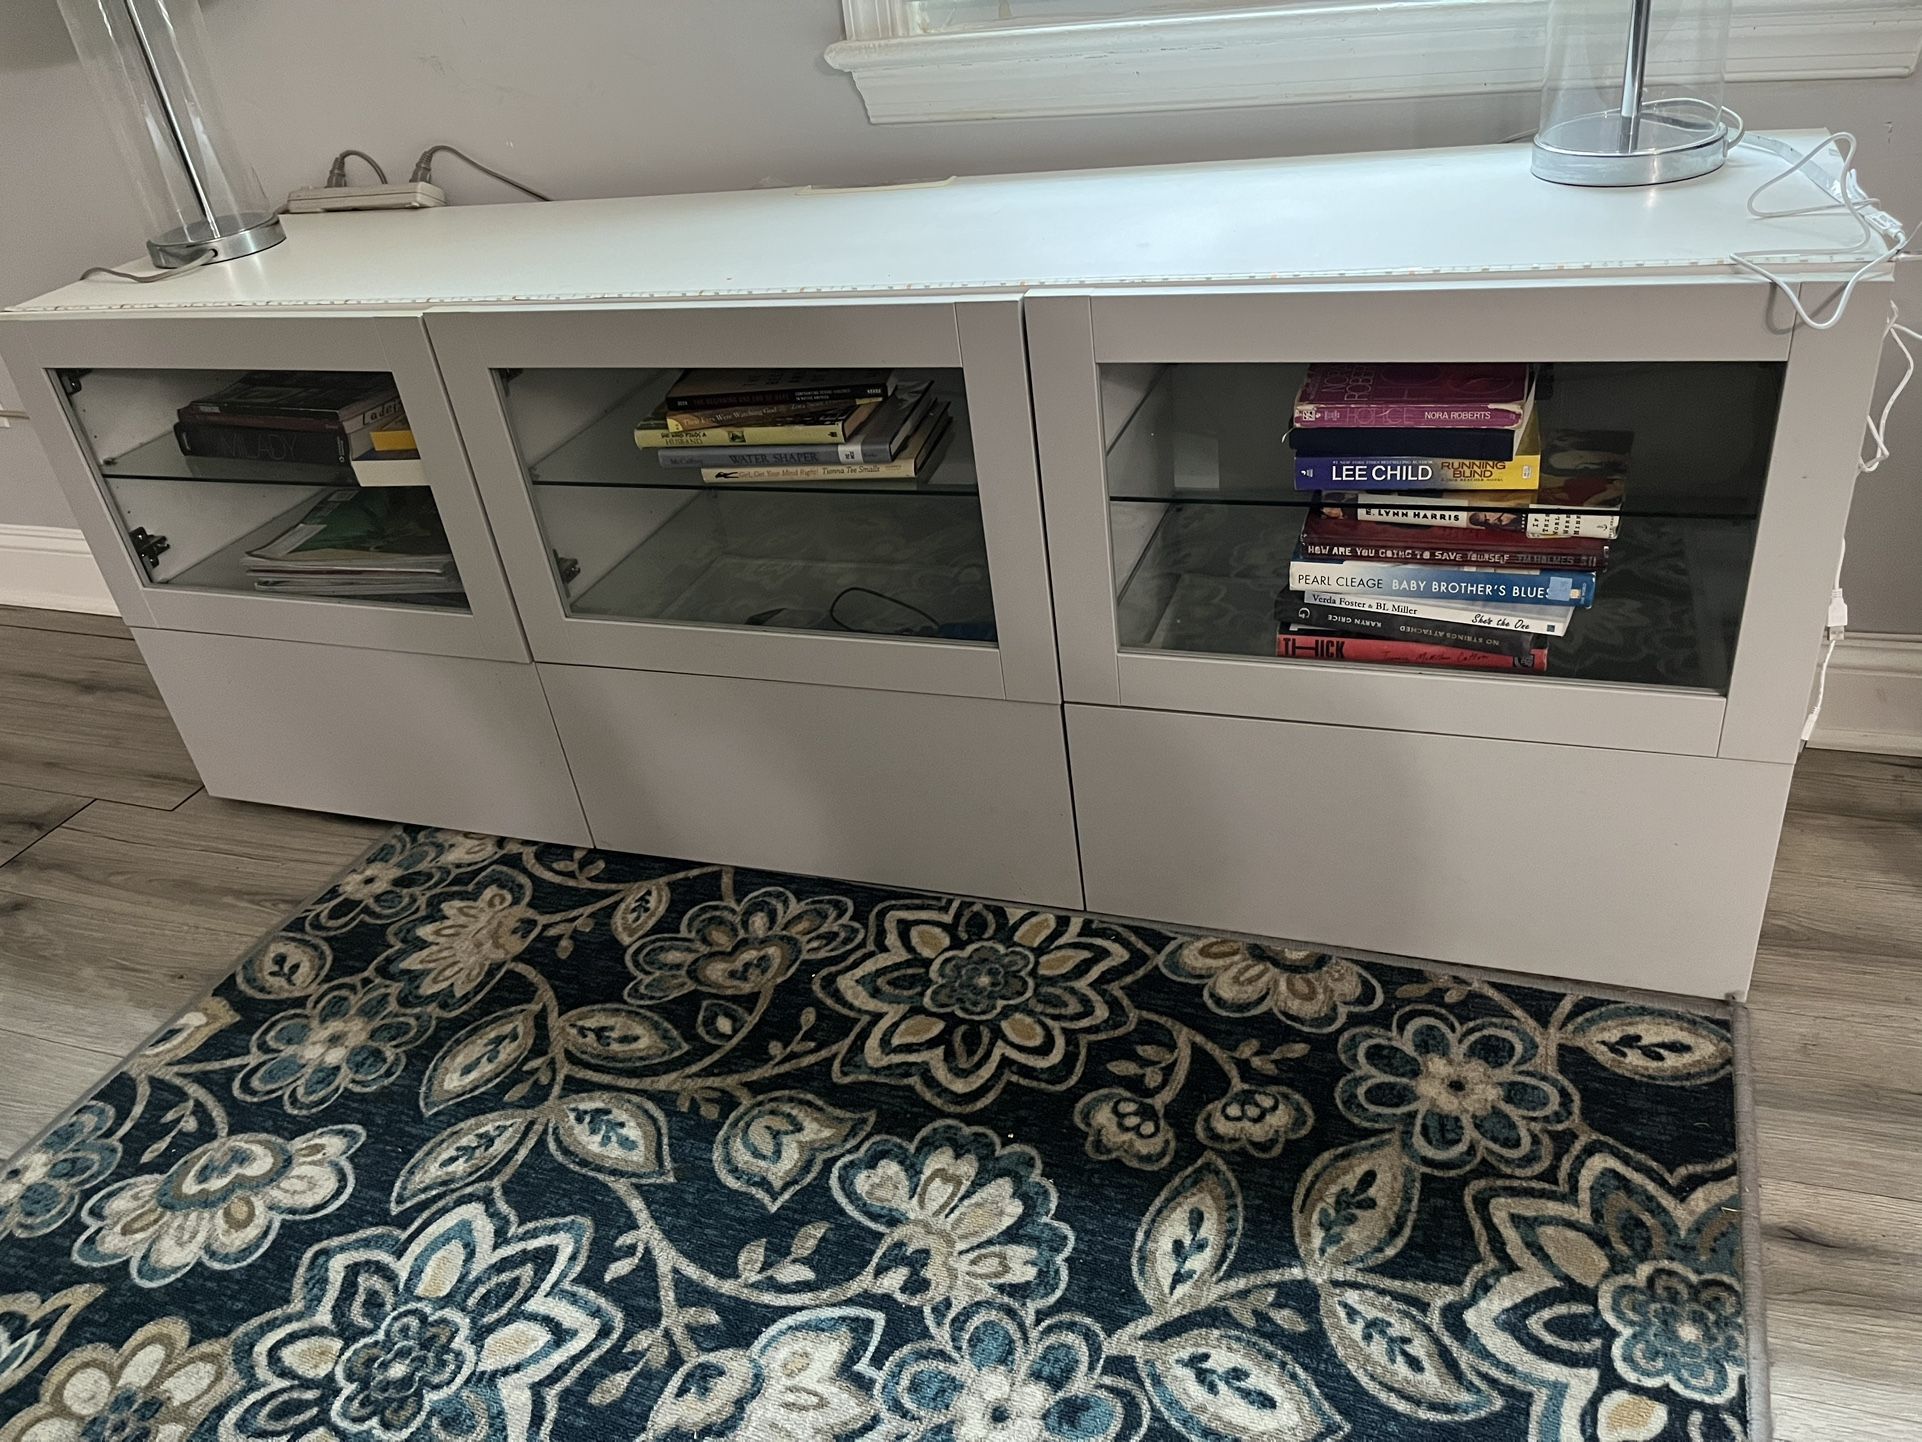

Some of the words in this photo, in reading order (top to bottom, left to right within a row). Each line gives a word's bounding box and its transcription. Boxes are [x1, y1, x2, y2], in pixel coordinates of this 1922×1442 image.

[1425, 411, 1449, 420] NORA
[1450, 411, 1491, 421] ROBERTS
[728, 454, 770, 465] WATER
[773, 451, 818, 464] SHAPER
[846, 466, 857, 474] Tee
[1440, 461, 1506, 470] RUNNING
[1332, 465, 1368, 480] LEE
[1371, 465, 1433, 481] CHILD
[1452, 469, 1493, 478] BLIND
[1377, 508, 1409, 520] LYNN
[1413, 510, 1460, 522] HARRIS
[1307, 545, 1329, 555] HOW
[1332, 546, 1352, 556] ARE
[1356, 547, 1376, 557] YOU
[1379, 549, 1412, 558] GOING
[1414, 550, 1431, 559] TO
[1434, 551, 1463, 561] SAVE
[1466, 551, 1510, 564] YOURSELF
[1297, 574, 1333, 587] PEARL
[1336, 576, 1384, 590] CLEAGE
[1391, 579, 1425, 592] BABY
[1431, 581, 1507, 597] BROTHER'S
[1312, 593, 1336, 605] Verda
[1338, 598, 1367, 609] Foster
[1375, 602, 1389, 612] BL
[1391, 604, 1418, 615] Miller
[1327, 613, 1353, 625] GRICE
[1354, 618, 1382, 628] KARYN
[1496, 616, 1511, 628] the
[1514, 618, 1531, 630] One
[1399, 625, 1450, 640] ATTACHED
[1449, 632, 1486, 644] STRINGS
[1283, 637, 1345, 660] THICK
[1485, 638, 1500, 646] NO
